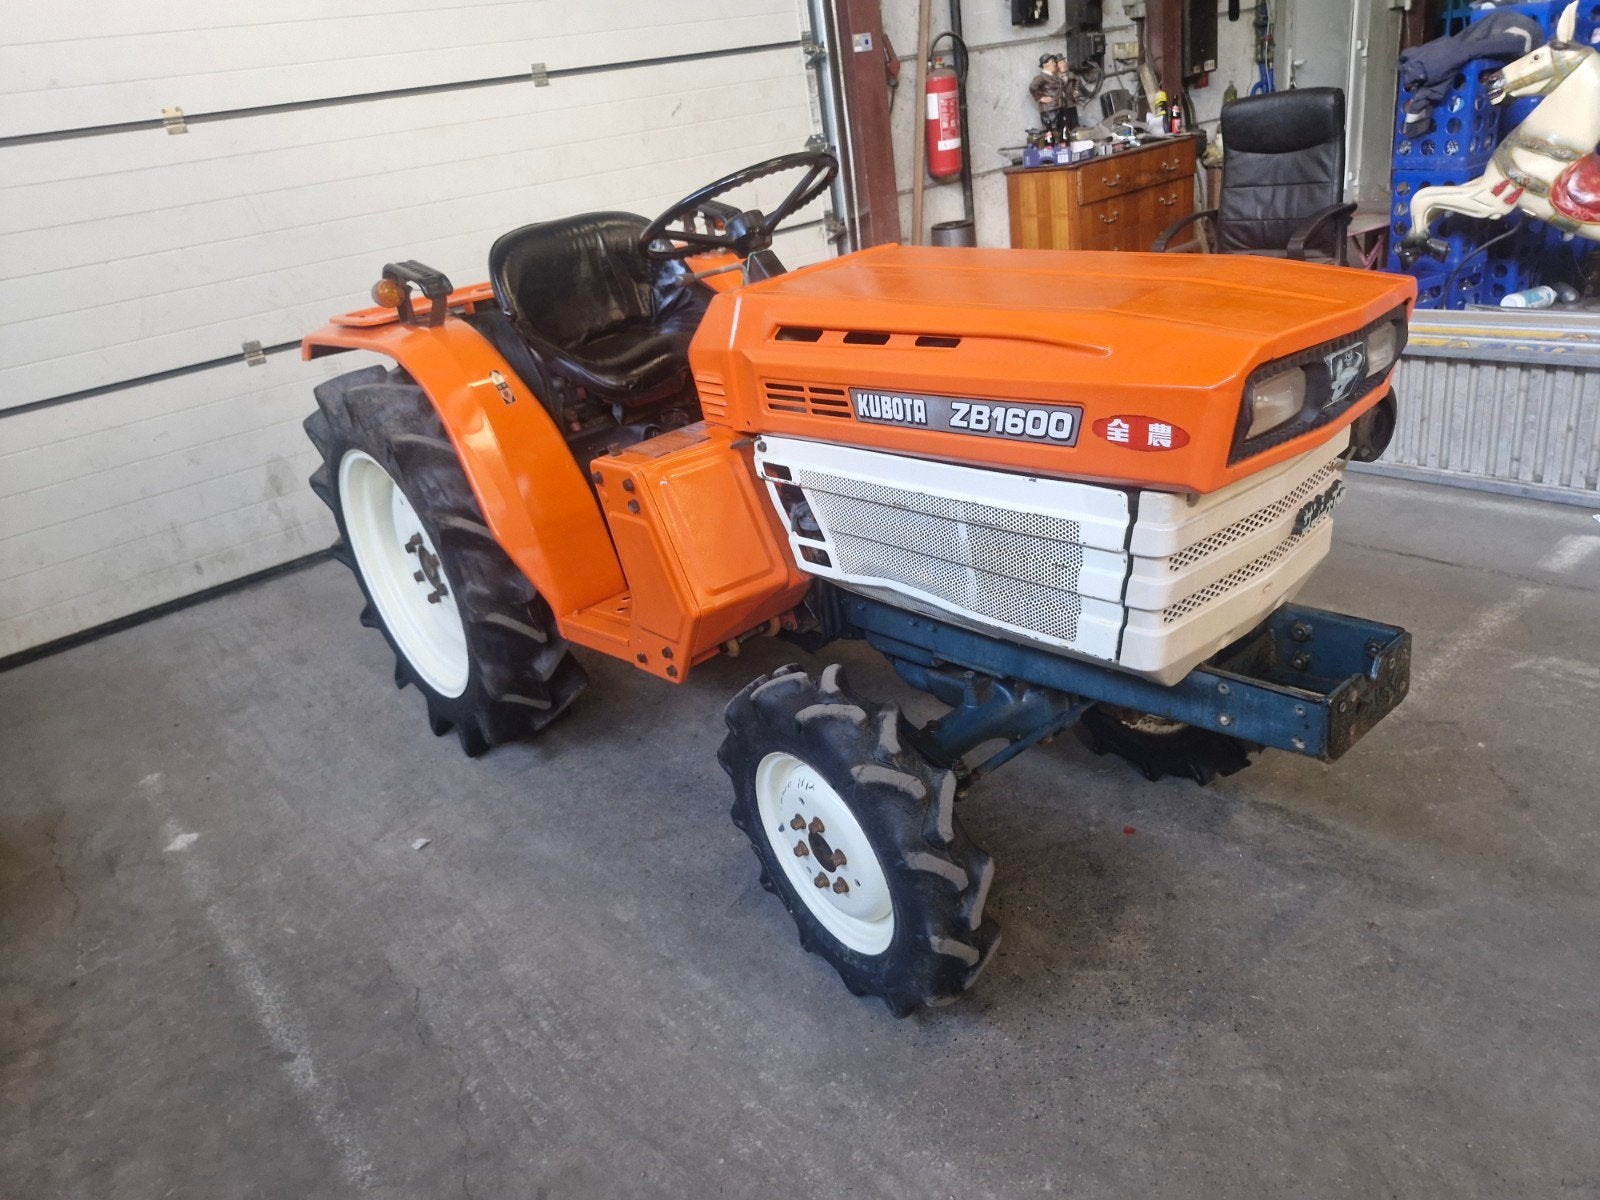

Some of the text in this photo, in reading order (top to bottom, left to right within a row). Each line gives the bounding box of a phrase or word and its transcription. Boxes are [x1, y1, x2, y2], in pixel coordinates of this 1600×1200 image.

[857, 393, 1073, 440] KUBOTA ZB1600
[1107, 418, 1172, 448] 全農
